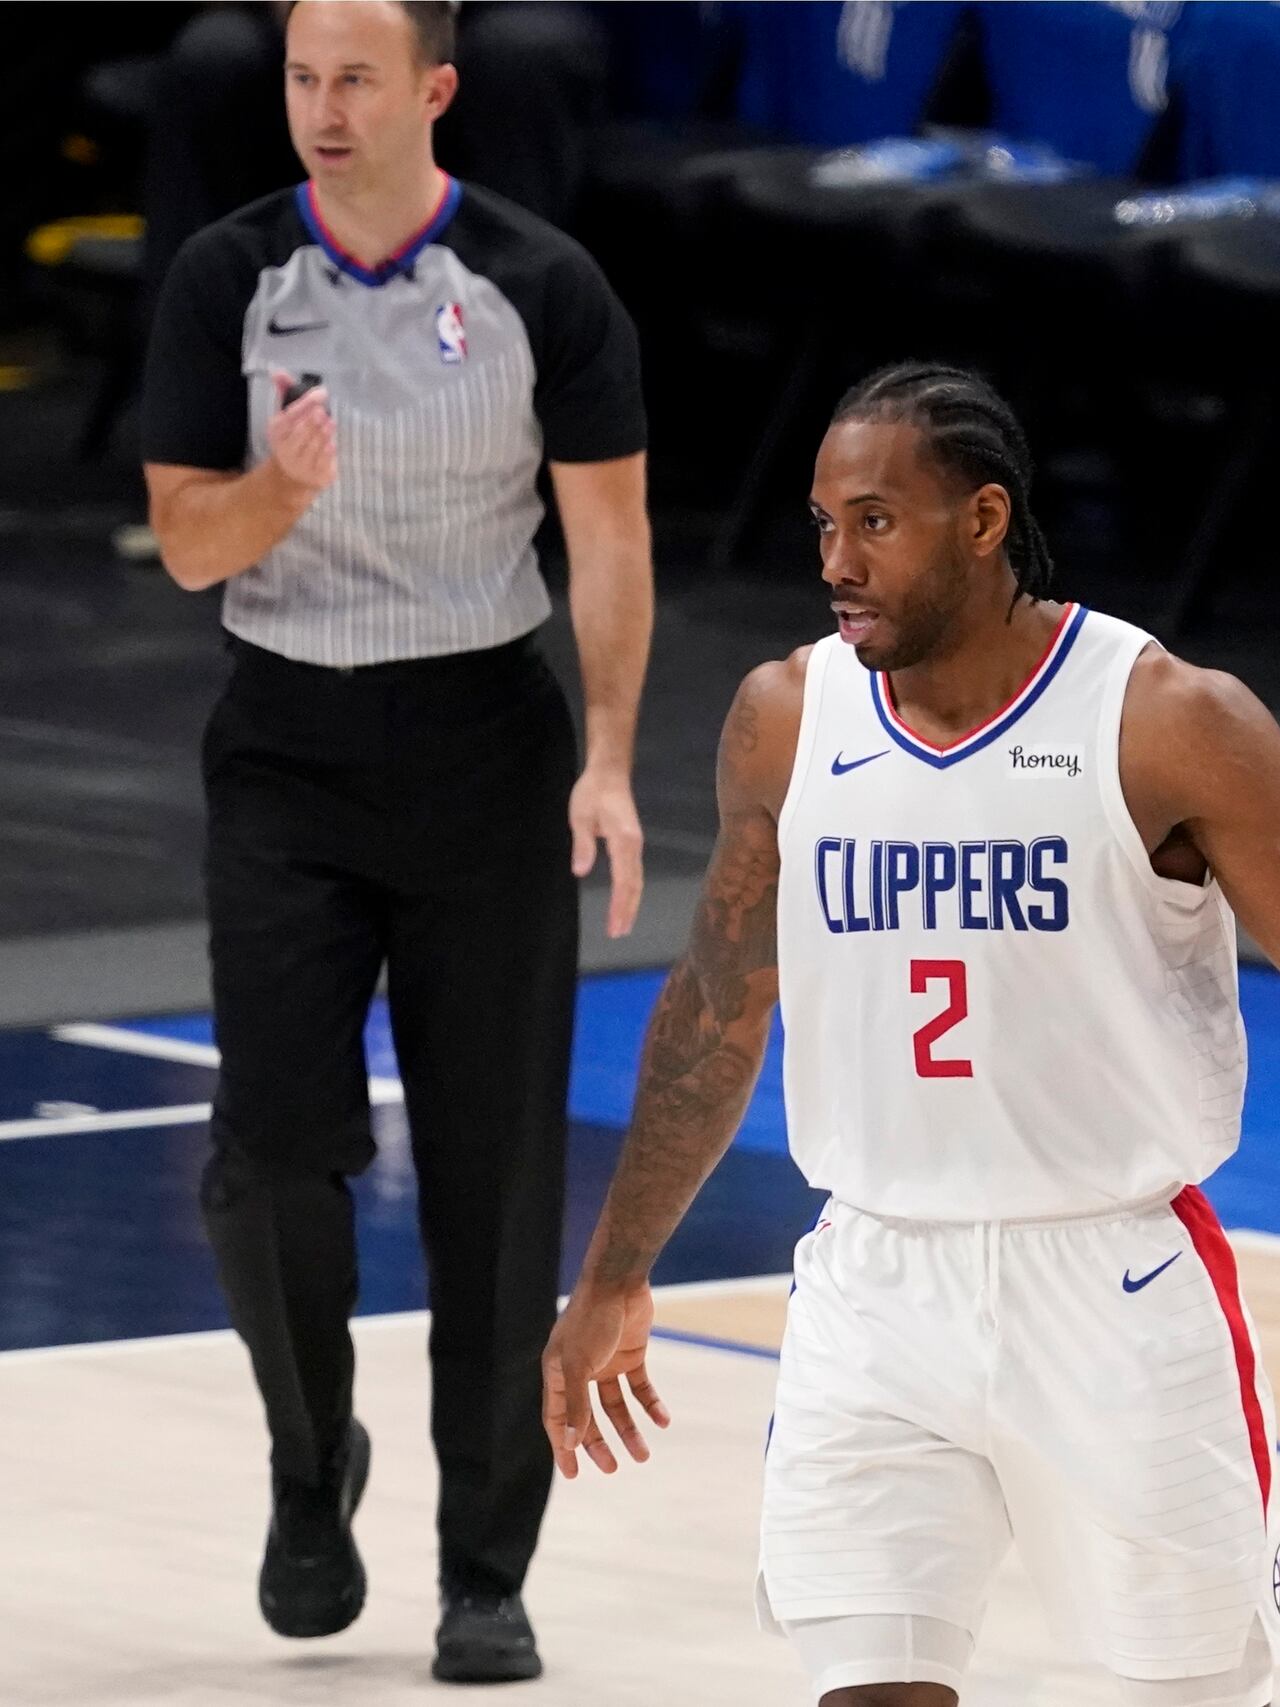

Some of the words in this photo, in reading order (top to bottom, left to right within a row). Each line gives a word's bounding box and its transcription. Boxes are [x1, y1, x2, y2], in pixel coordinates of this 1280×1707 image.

[1008, 745, 1082, 777] honey
[814, 835, 1070, 934] CLIPPERS
[909, 958, 974, 1079] 2
